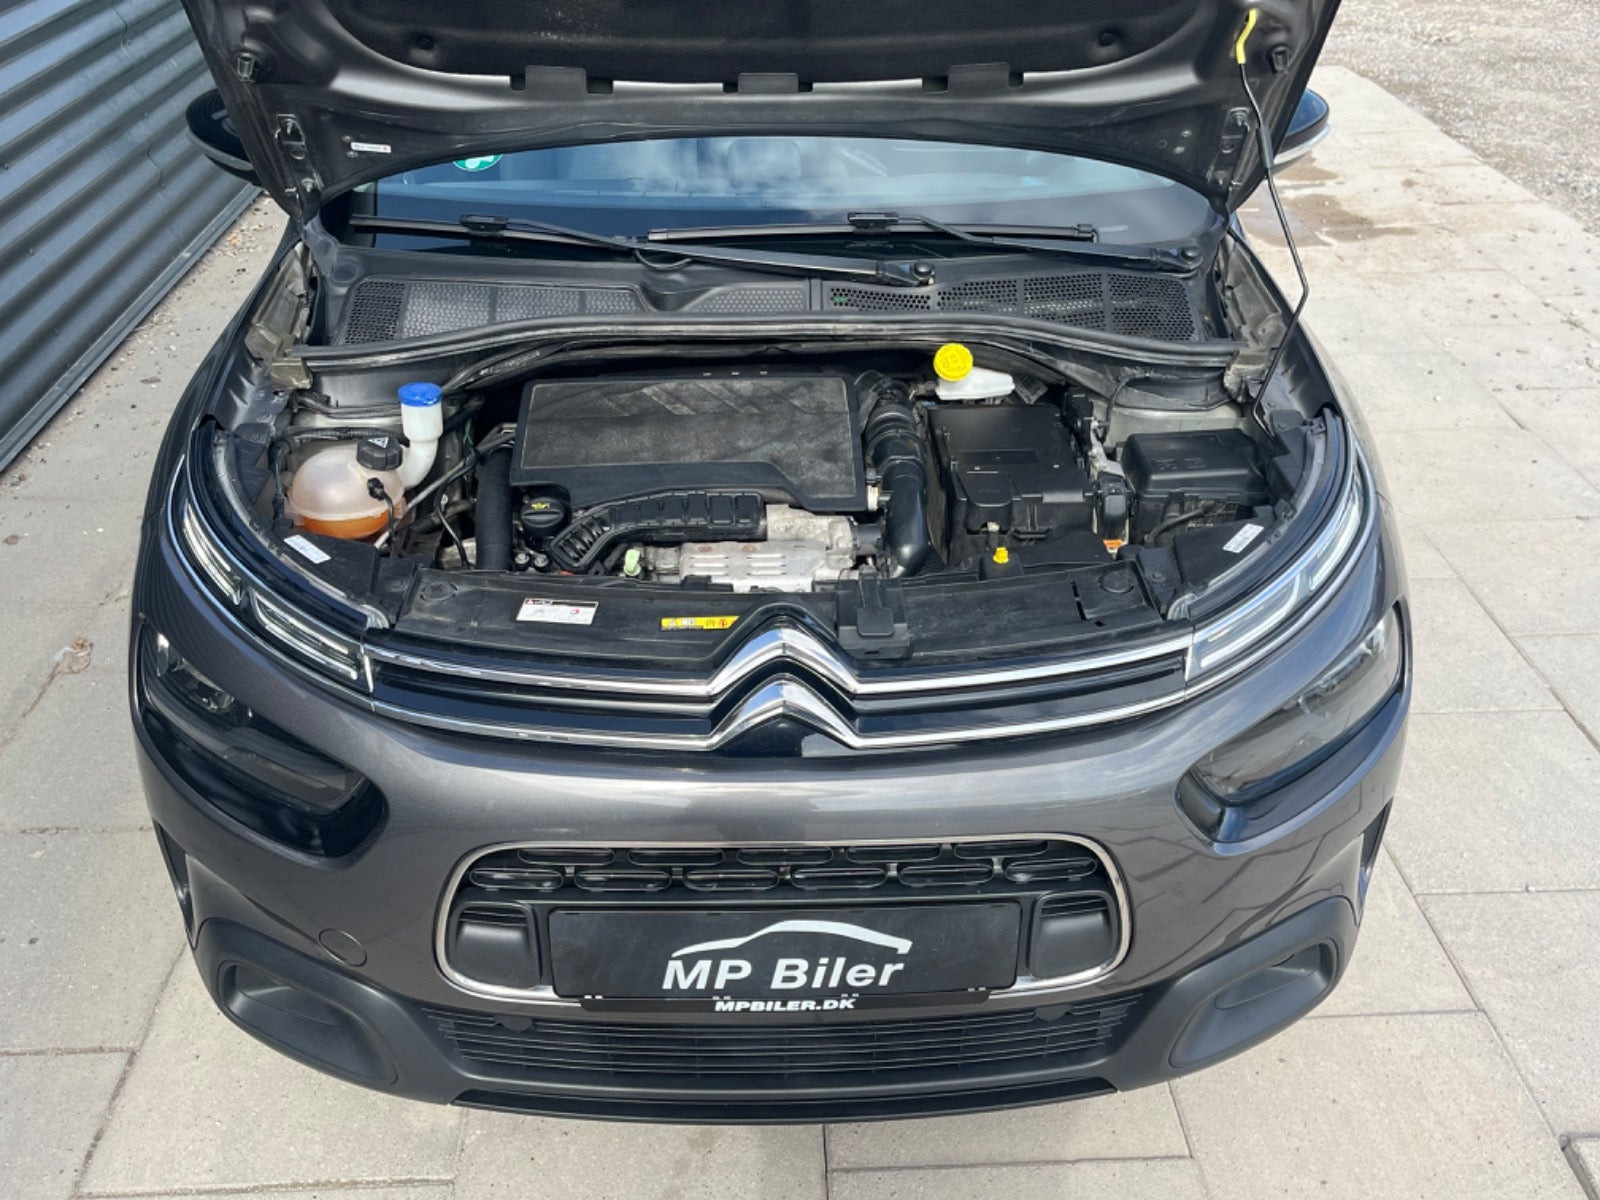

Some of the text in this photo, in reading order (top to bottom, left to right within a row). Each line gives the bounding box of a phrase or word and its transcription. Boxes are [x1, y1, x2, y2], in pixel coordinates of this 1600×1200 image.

[662, 957, 904, 989] MP Biler
[714, 998, 856, 1012] MPBILER.DK
